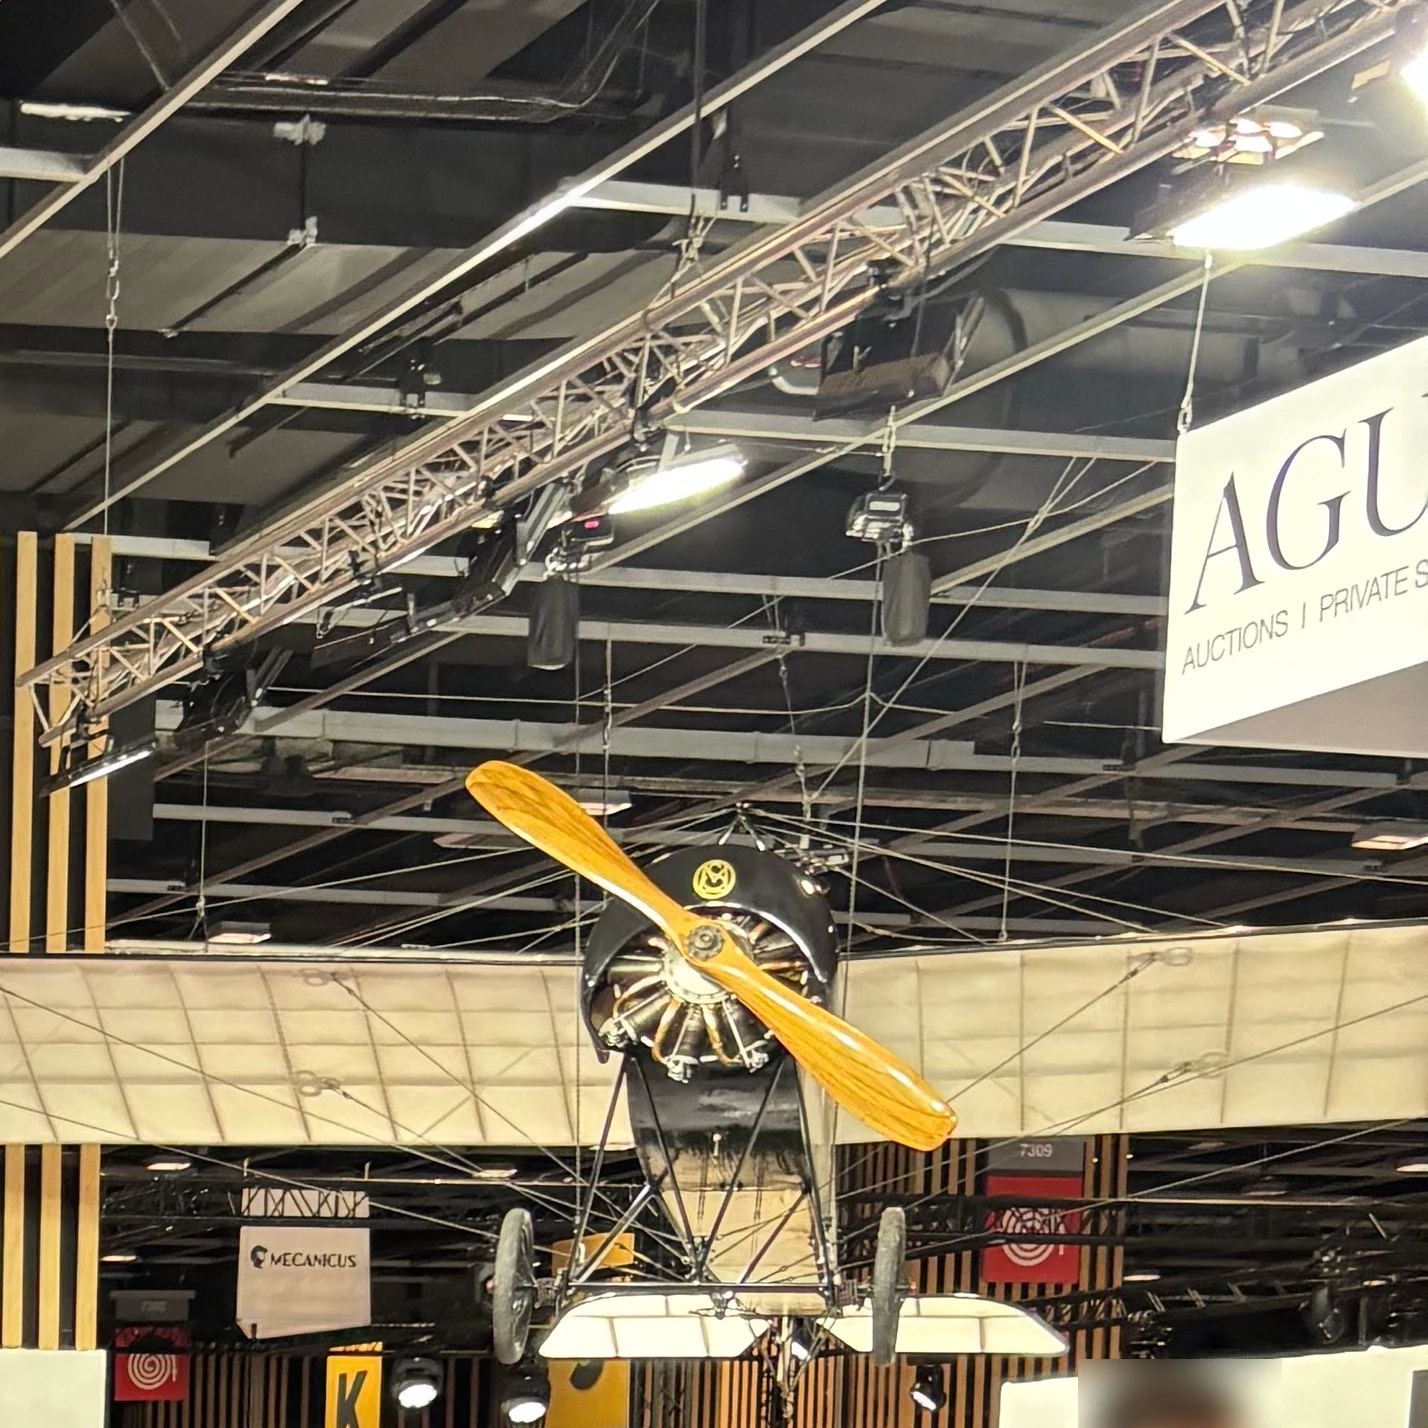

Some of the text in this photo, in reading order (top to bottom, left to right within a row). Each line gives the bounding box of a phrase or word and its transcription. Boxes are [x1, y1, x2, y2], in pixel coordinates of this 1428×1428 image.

[1181, 609, 1289, 675] AUCTIONS
[1319, 565, 1409, 622] PRIVATE
[1020, 1143, 1053, 1158] 7309
[270, 1252, 357, 1268] MECANICUS
